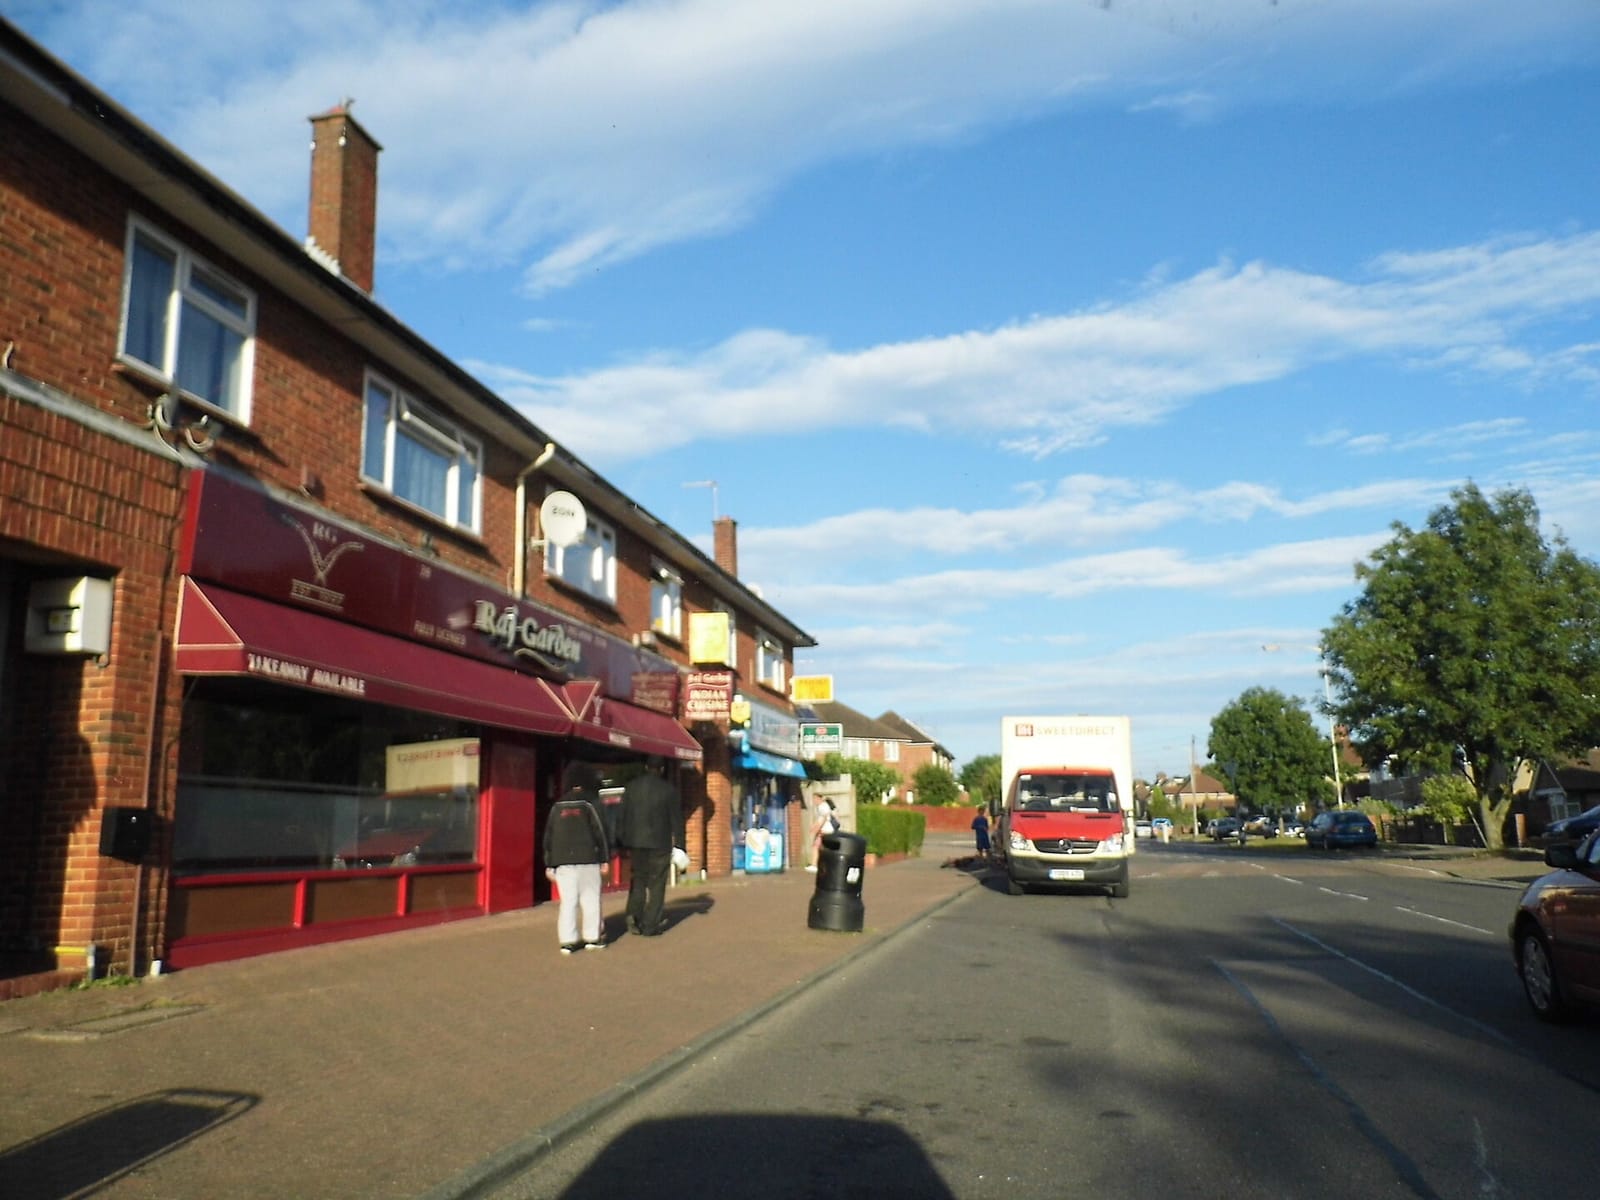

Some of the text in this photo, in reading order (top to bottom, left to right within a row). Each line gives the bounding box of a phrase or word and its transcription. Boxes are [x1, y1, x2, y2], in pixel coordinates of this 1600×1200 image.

[247, 653, 365, 694] TAKEAWAY AVAILABLE
[689, 689, 727, 700] INDIAN
